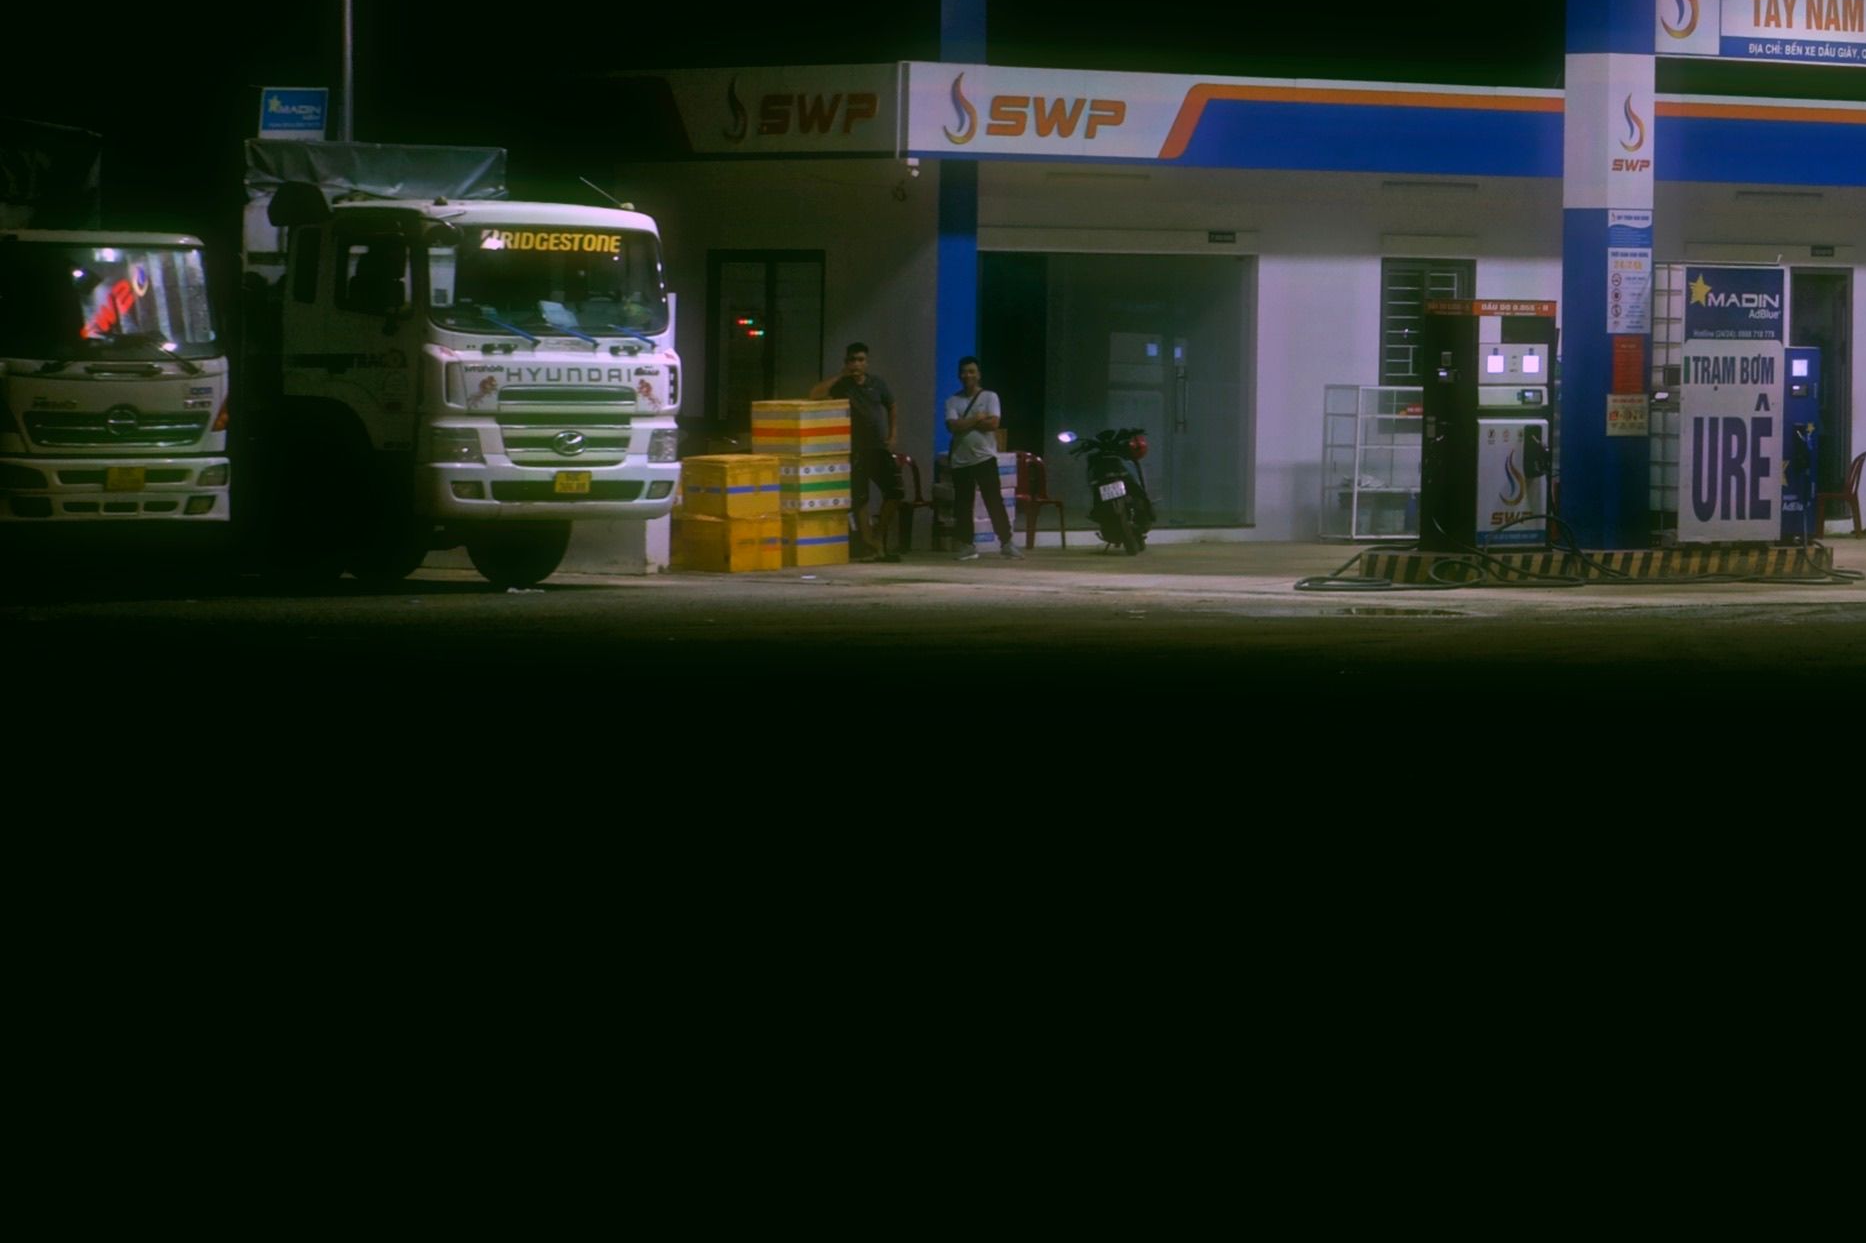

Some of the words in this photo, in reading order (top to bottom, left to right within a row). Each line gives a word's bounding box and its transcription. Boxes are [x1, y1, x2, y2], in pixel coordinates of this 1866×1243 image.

[1749, 43, 1764, 55] ĐỊA
[1805, 46, 1816, 56] XE
[757, 92, 879, 136] SWP
[986, 96, 1127, 139] SWP
[1611, 159, 1650, 172] SWP
[480, 228, 622, 253] BRIDGESTONE
[1707, 293, 1779, 308] MADIN
[506, 367, 632, 383] HYUNDAI
[1692, 356, 1736, 391] TRẠM
[1740, 354, 1774, 384] BƠM
[1692, 393, 1773, 522] URÊ
